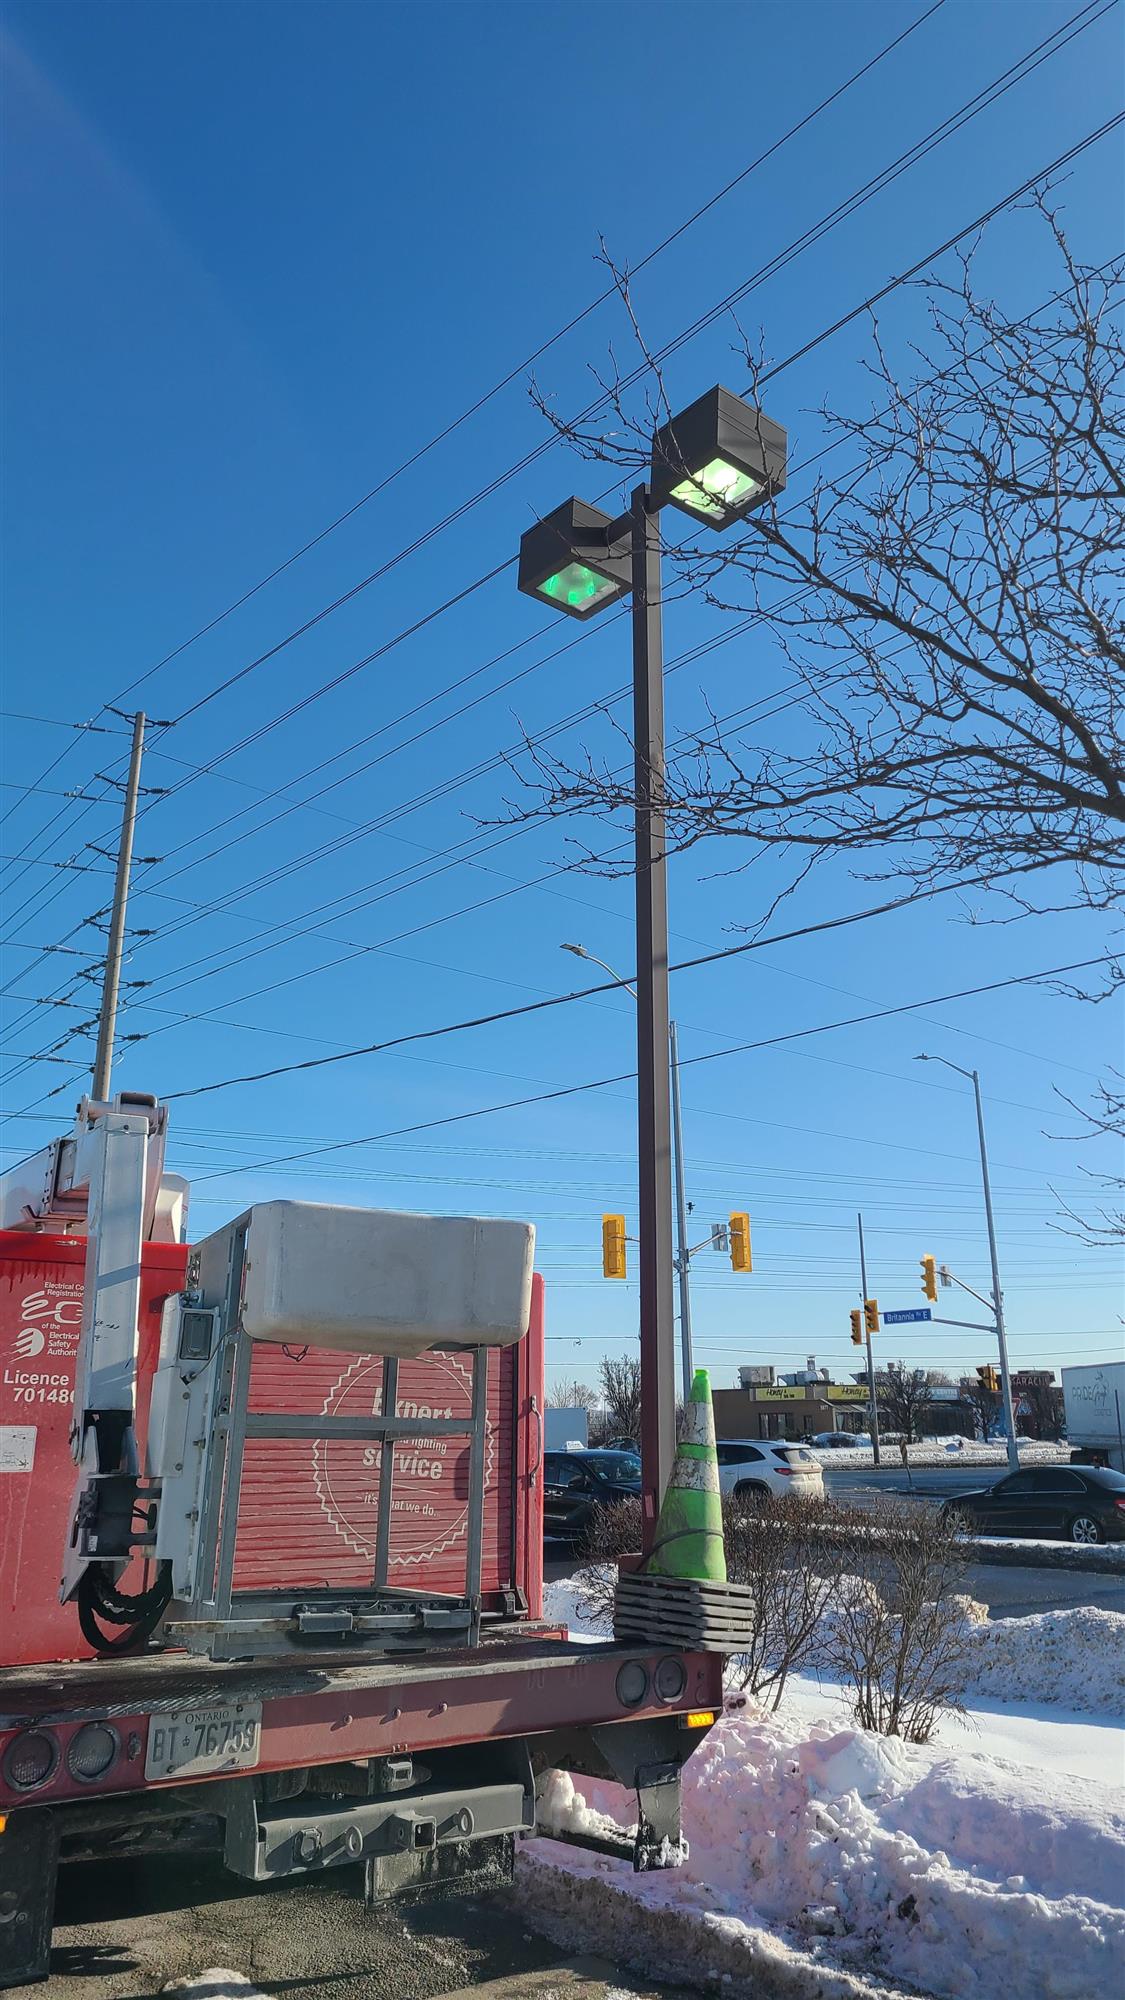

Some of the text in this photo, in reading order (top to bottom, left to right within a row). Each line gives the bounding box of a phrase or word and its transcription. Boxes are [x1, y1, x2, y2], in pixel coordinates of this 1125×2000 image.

[44, 1282, 74, 1290] Electrical
[887, 1312, 915, 1322] Britannia
[923, 1311, 928, 1320] E
[48, 1340, 72, 1348] Safety
[47, 1348, 78, 1356] Authorit
[3, 1369, 69, 1386] Licence
[405, 1501, 420, 1513] we
[185, 1710, 230, 1724] ONTARIO
[152, 1719, 255, 1763] BT 76759
